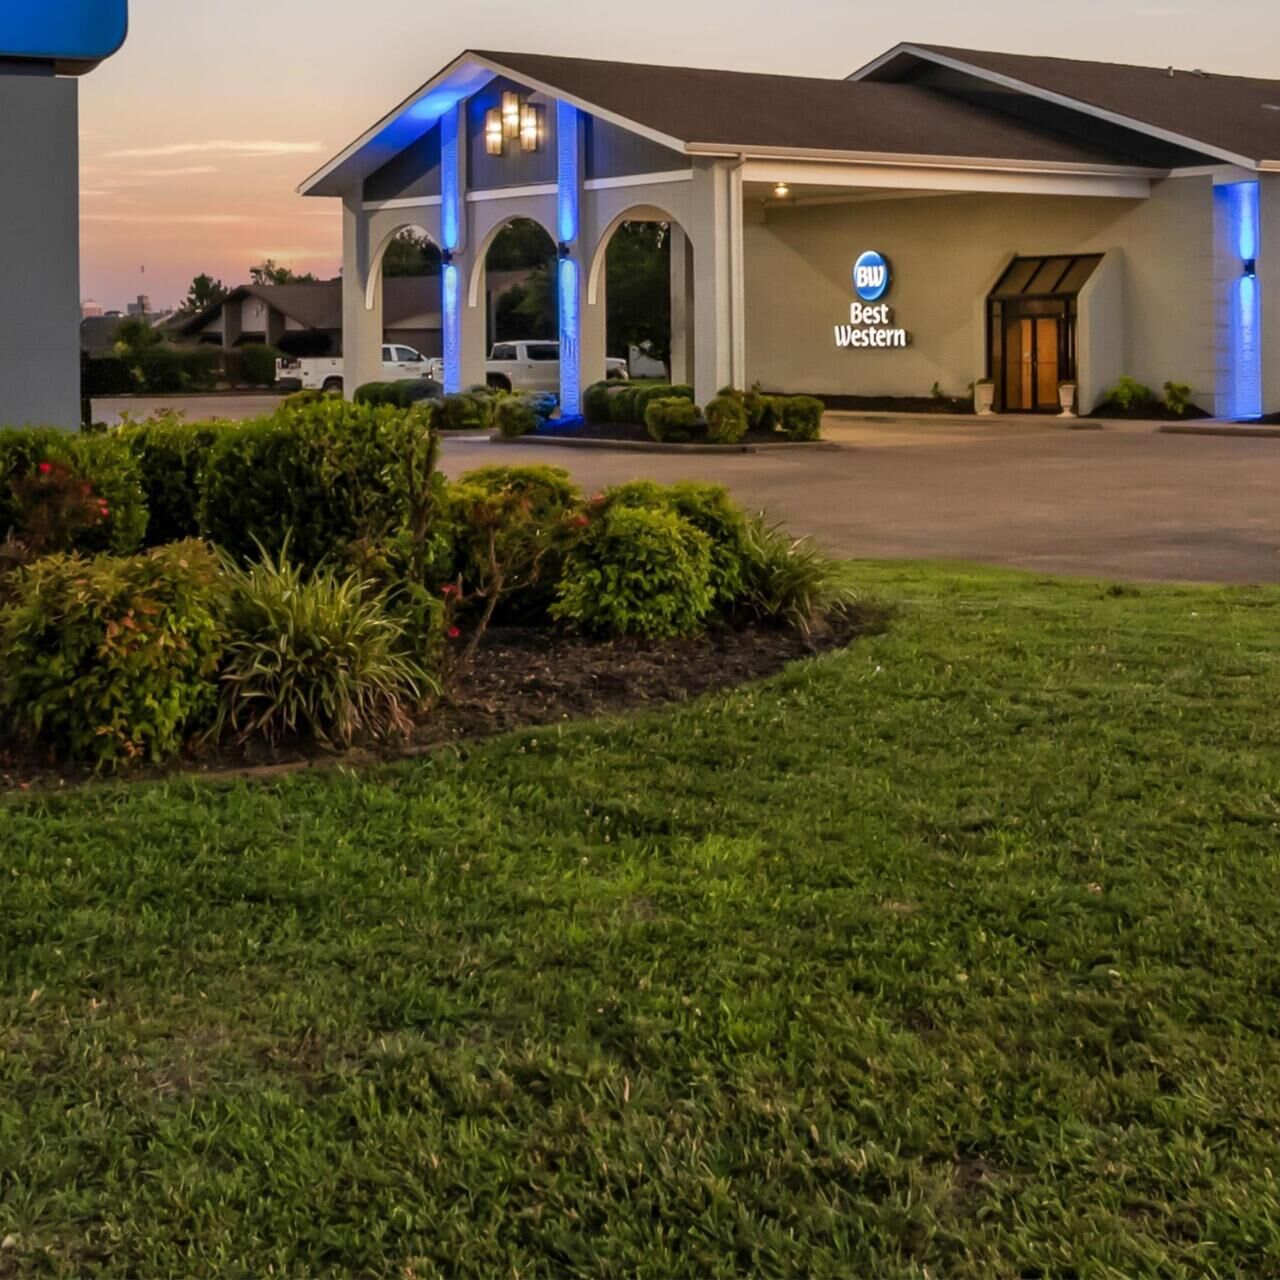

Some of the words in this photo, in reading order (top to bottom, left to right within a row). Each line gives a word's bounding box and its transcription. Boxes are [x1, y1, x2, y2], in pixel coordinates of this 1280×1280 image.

[856, 265, 885, 287] BW
[850, 302, 889, 324] Best
[834, 325, 906, 347] Western
